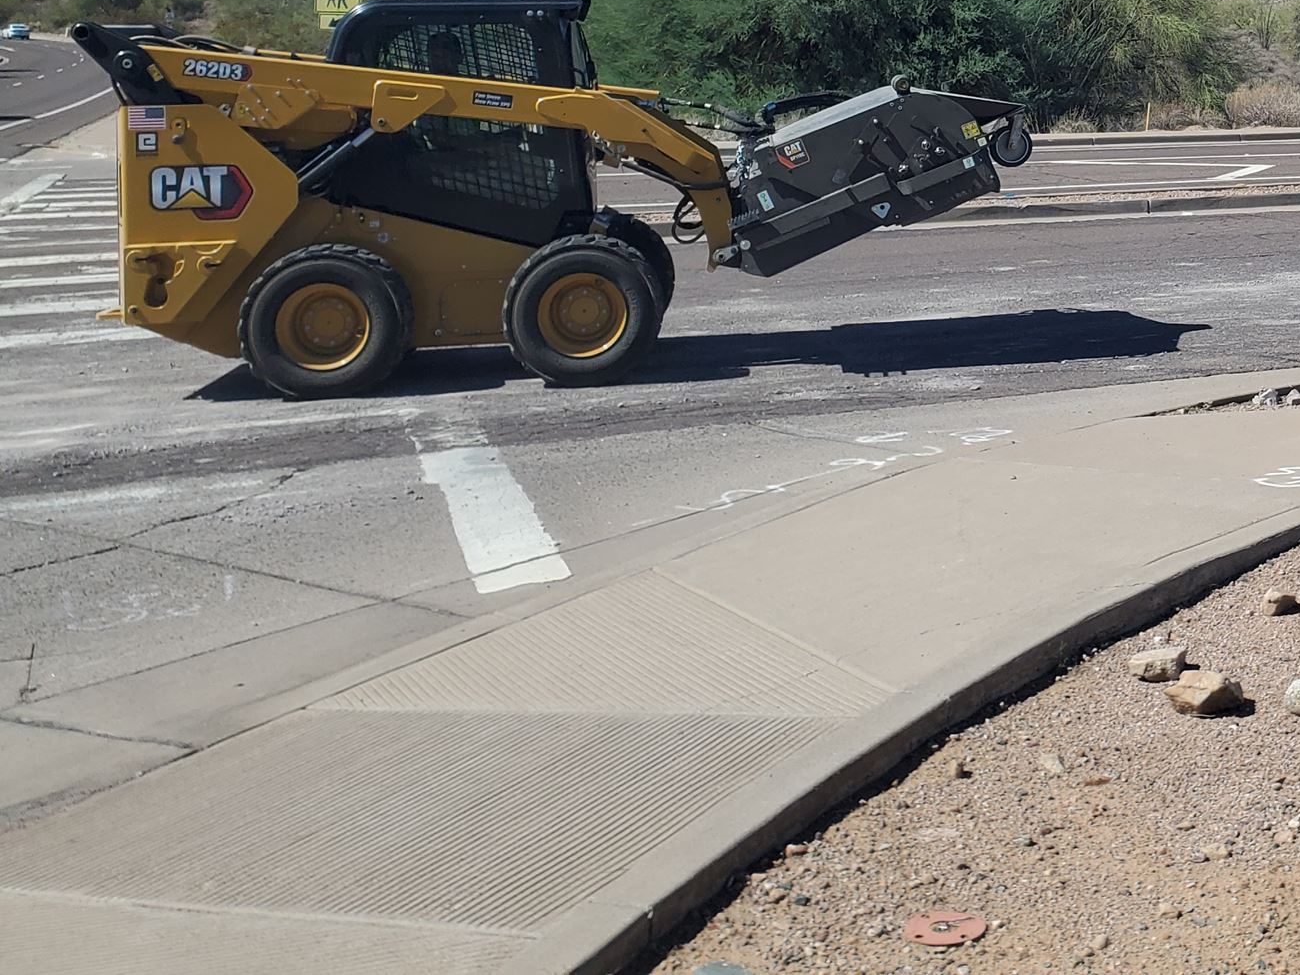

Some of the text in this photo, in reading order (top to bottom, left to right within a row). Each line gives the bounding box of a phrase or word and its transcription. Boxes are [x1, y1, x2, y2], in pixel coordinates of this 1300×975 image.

[183, 58, 243, 80] 262D3
[784, 141, 802, 157] CAT
[151, 166, 228, 209] CAT
